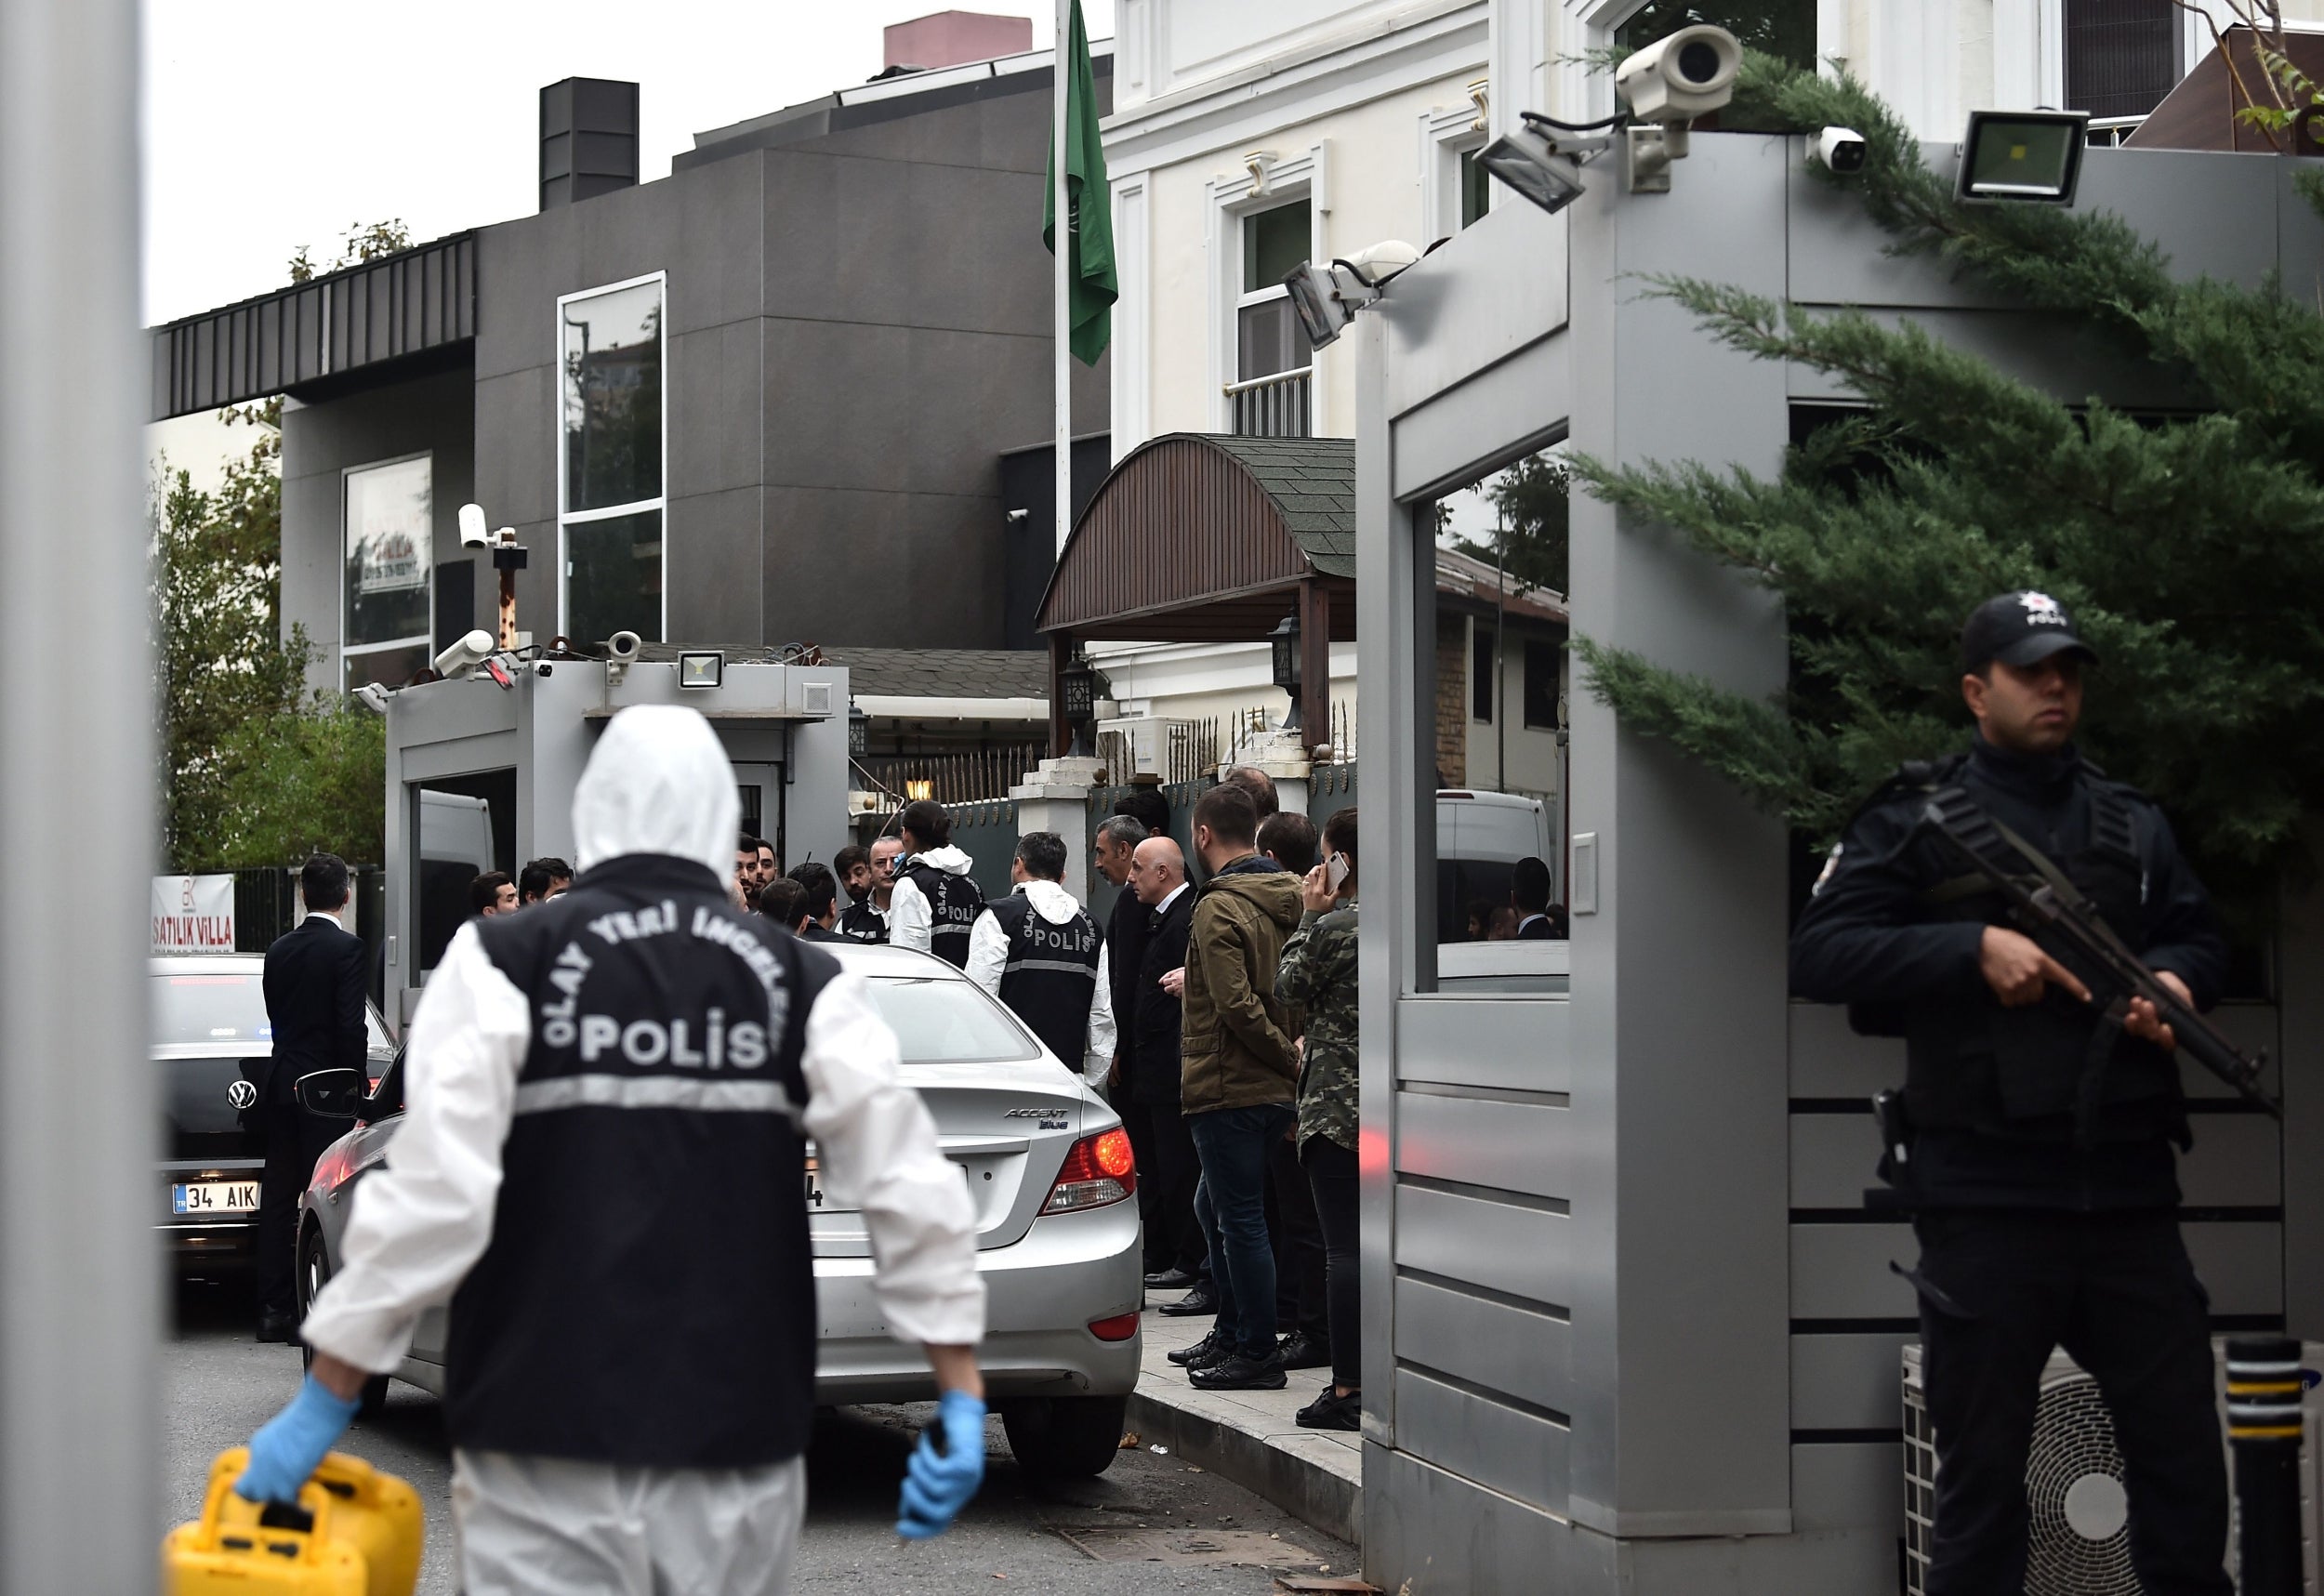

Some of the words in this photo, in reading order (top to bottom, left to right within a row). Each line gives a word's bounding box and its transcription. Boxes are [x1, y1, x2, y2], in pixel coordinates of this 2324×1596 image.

[937, 882, 947, 916] OLAY
[948, 904, 977, 922] POLİ
[152, 916, 193, 945] SATILIK
[1035, 929, 1090, 953] POLİS
[541, 941, 593, 1049] OLAY
[588, 899, 680, 945] YERİ
[579, 1006, 769, 1070] POLİS
[1004, 1108, 1069, 1118] ACCENT
[1039, 1118, 1069, 1130] blue
[189, 1187, 213, 1208] 34
[227, 1185, 256, 1207] AIK
